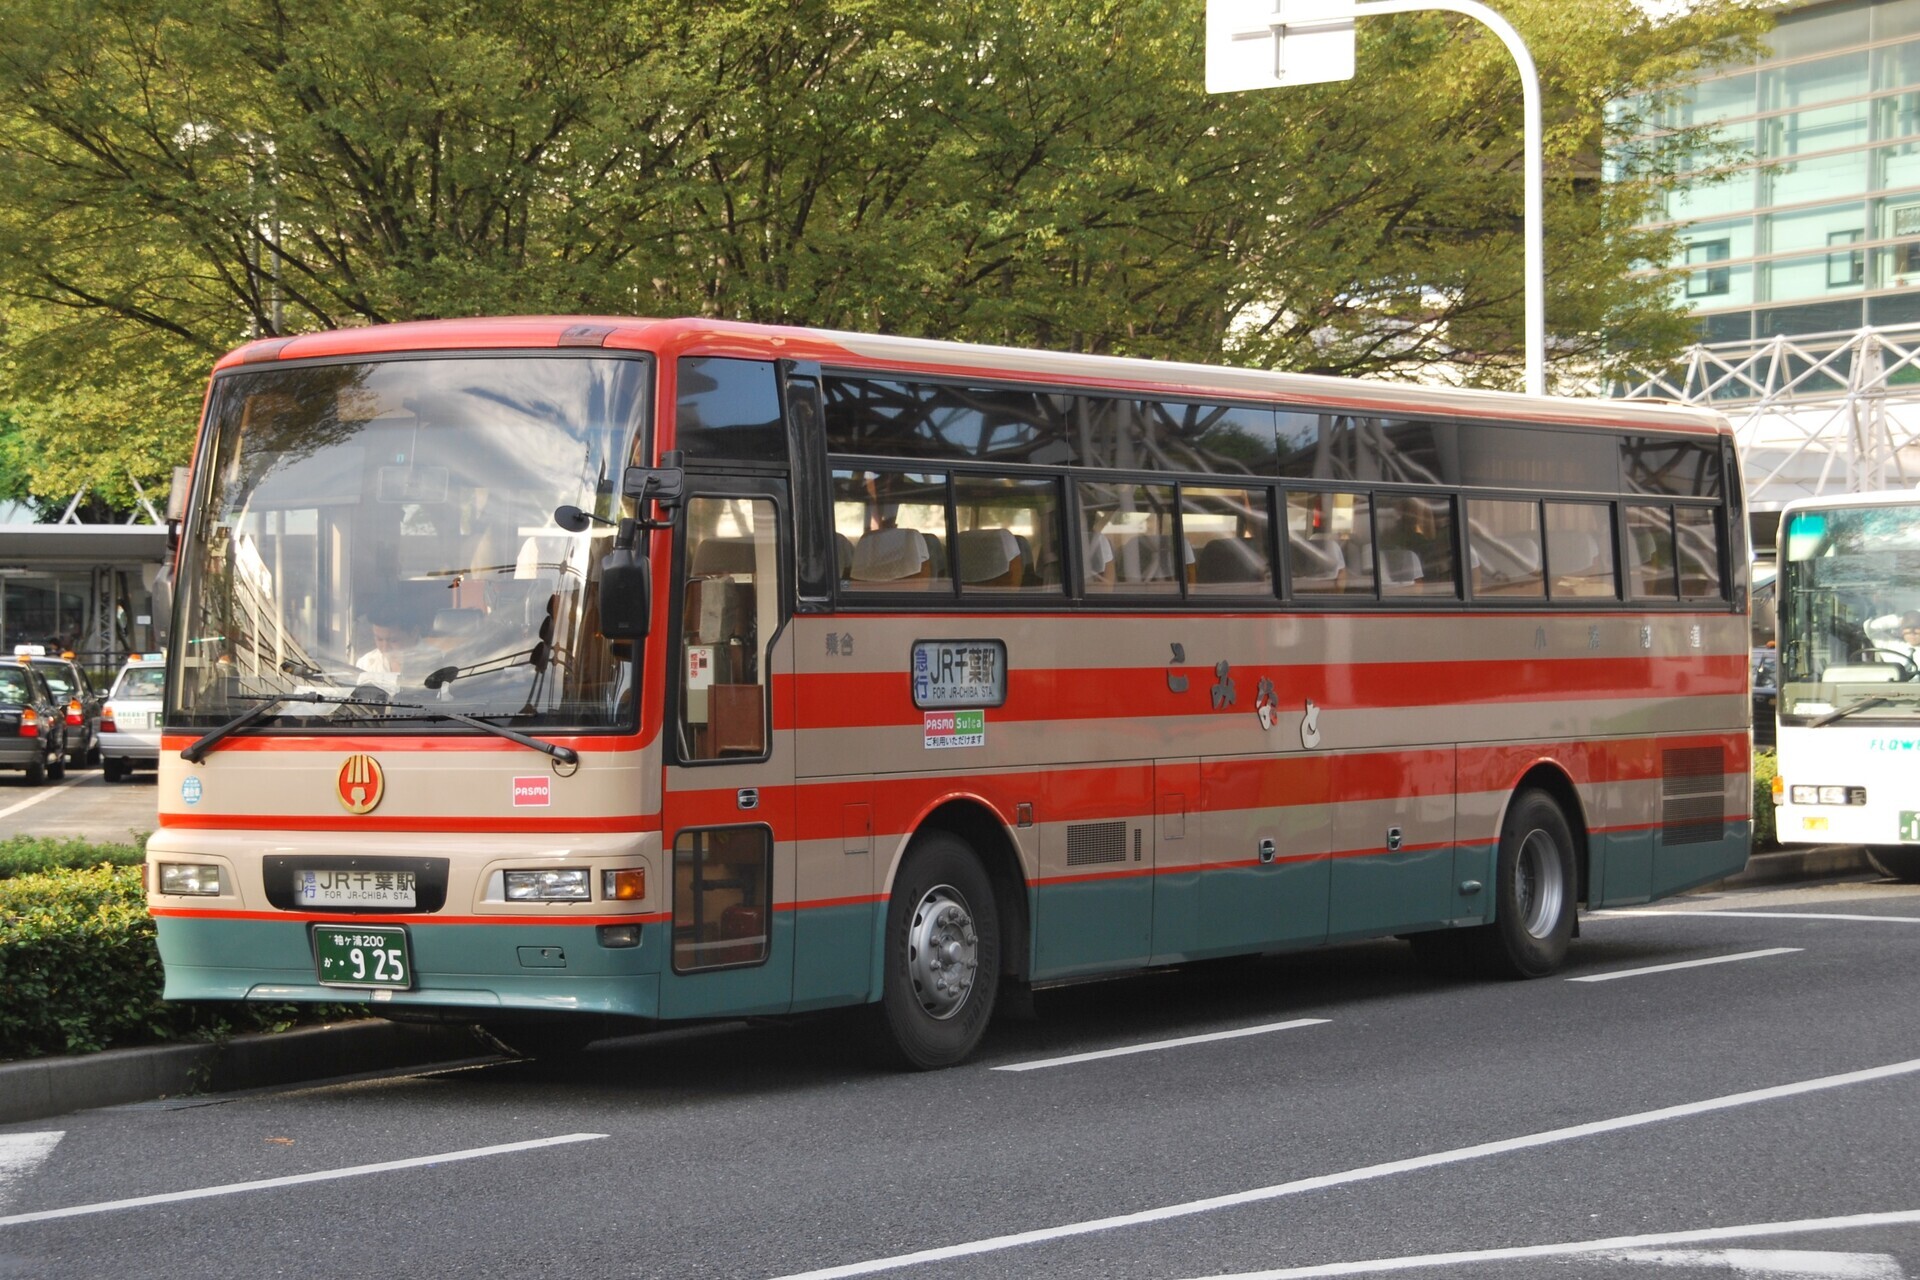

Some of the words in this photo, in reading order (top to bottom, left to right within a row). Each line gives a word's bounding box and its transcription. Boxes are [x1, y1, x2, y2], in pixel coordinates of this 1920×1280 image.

[930, 648, 995, 684] JR千葉駅
[915, 648, 928, 699] 急行
[933, 687, 946, 699] FOR
[949, 686, 979, 698] JR-CHIBA
[926, 718, 954, 730] PASMO
[956, 717, 981, 729] Suica
[926, 735, 982, 747] ご利用いただけます
[515, 787, 548, 796] PASMO
[304, 871, 316, 898] 急行
[320, 872, 416, 891] JR千葉駅
[325, 891, 341, 899] FOR
[347, 891, 387, 900] JR-CHIBA
[324, 957, 333, 968] か
